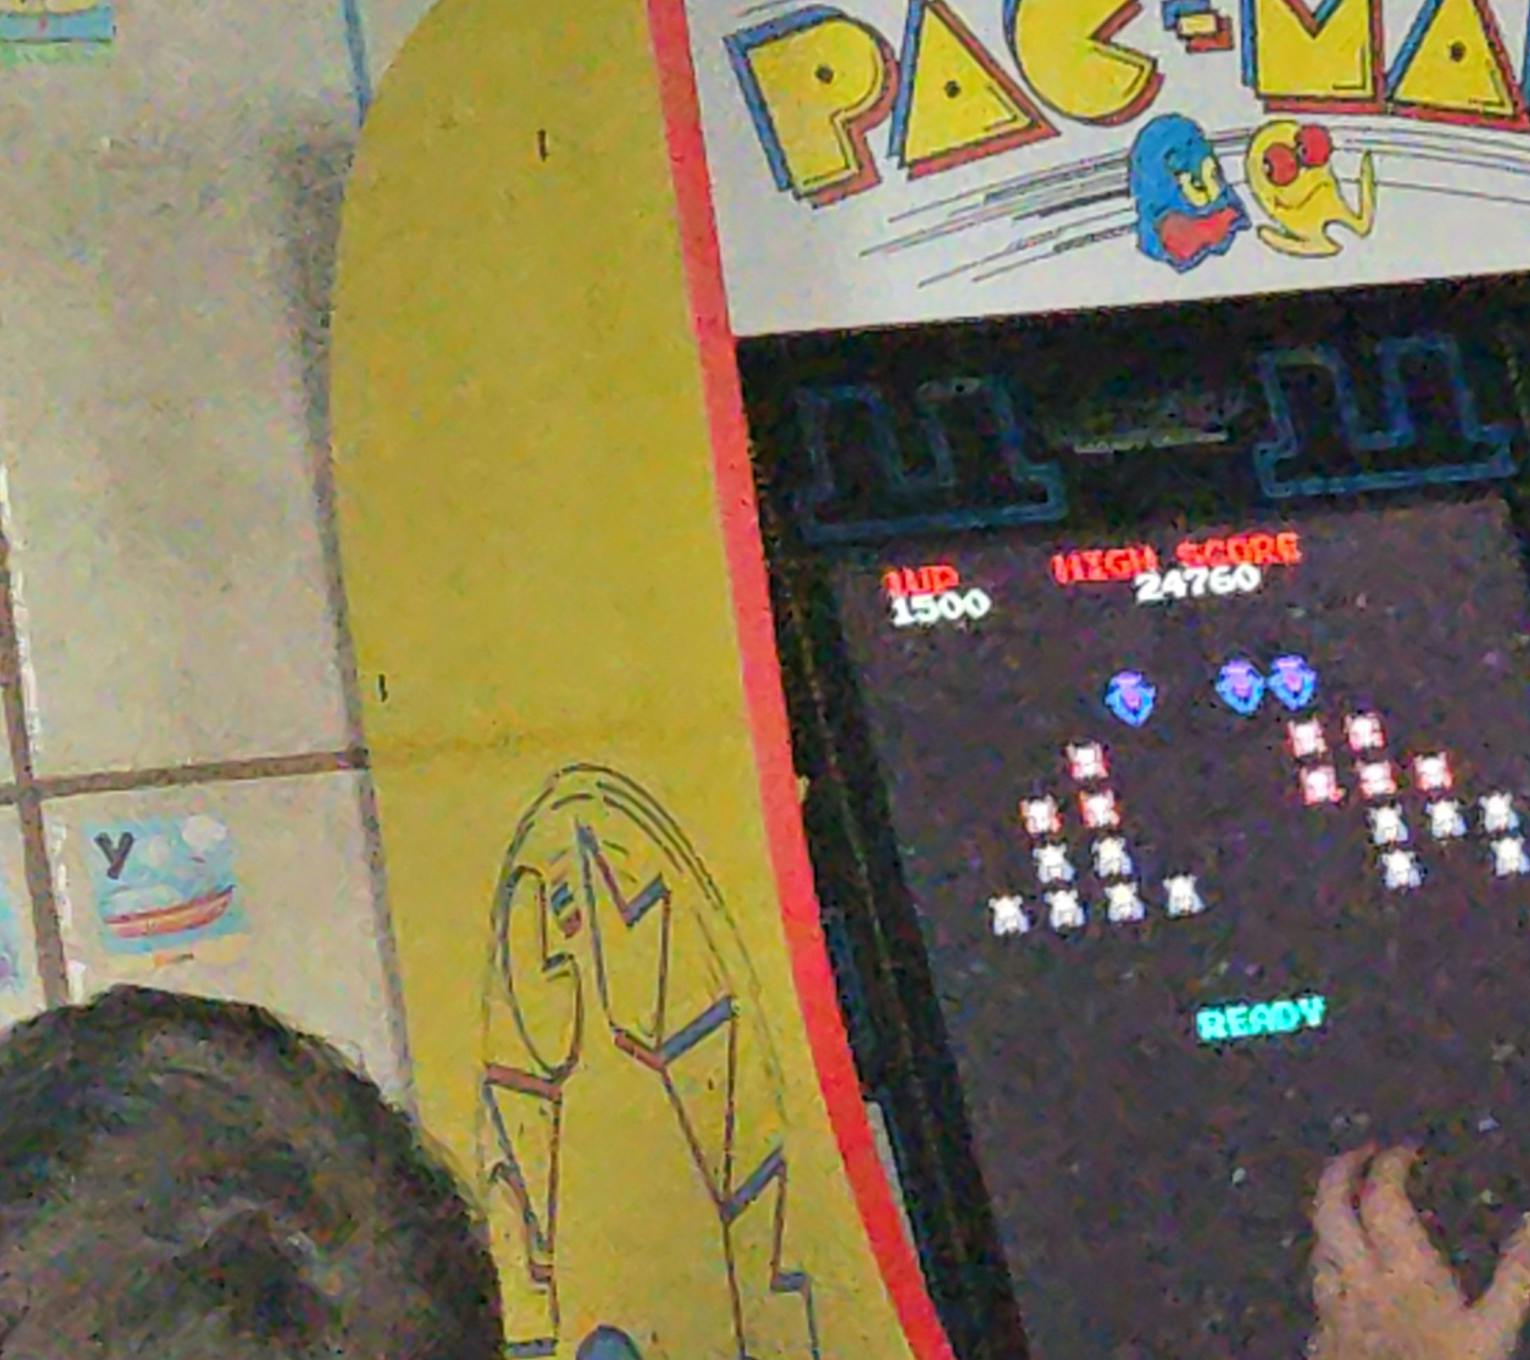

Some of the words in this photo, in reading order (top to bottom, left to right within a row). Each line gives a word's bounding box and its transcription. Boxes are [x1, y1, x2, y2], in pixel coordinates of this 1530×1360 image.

[1051, 546, 1158, 583] HIGH
[1176, 533, 1301, 568] SCORE
[1133, 562, 1261, 602] 24760
[892, 588, 992, 626] 1500
[1196, 995, 1326, 1040] READY
